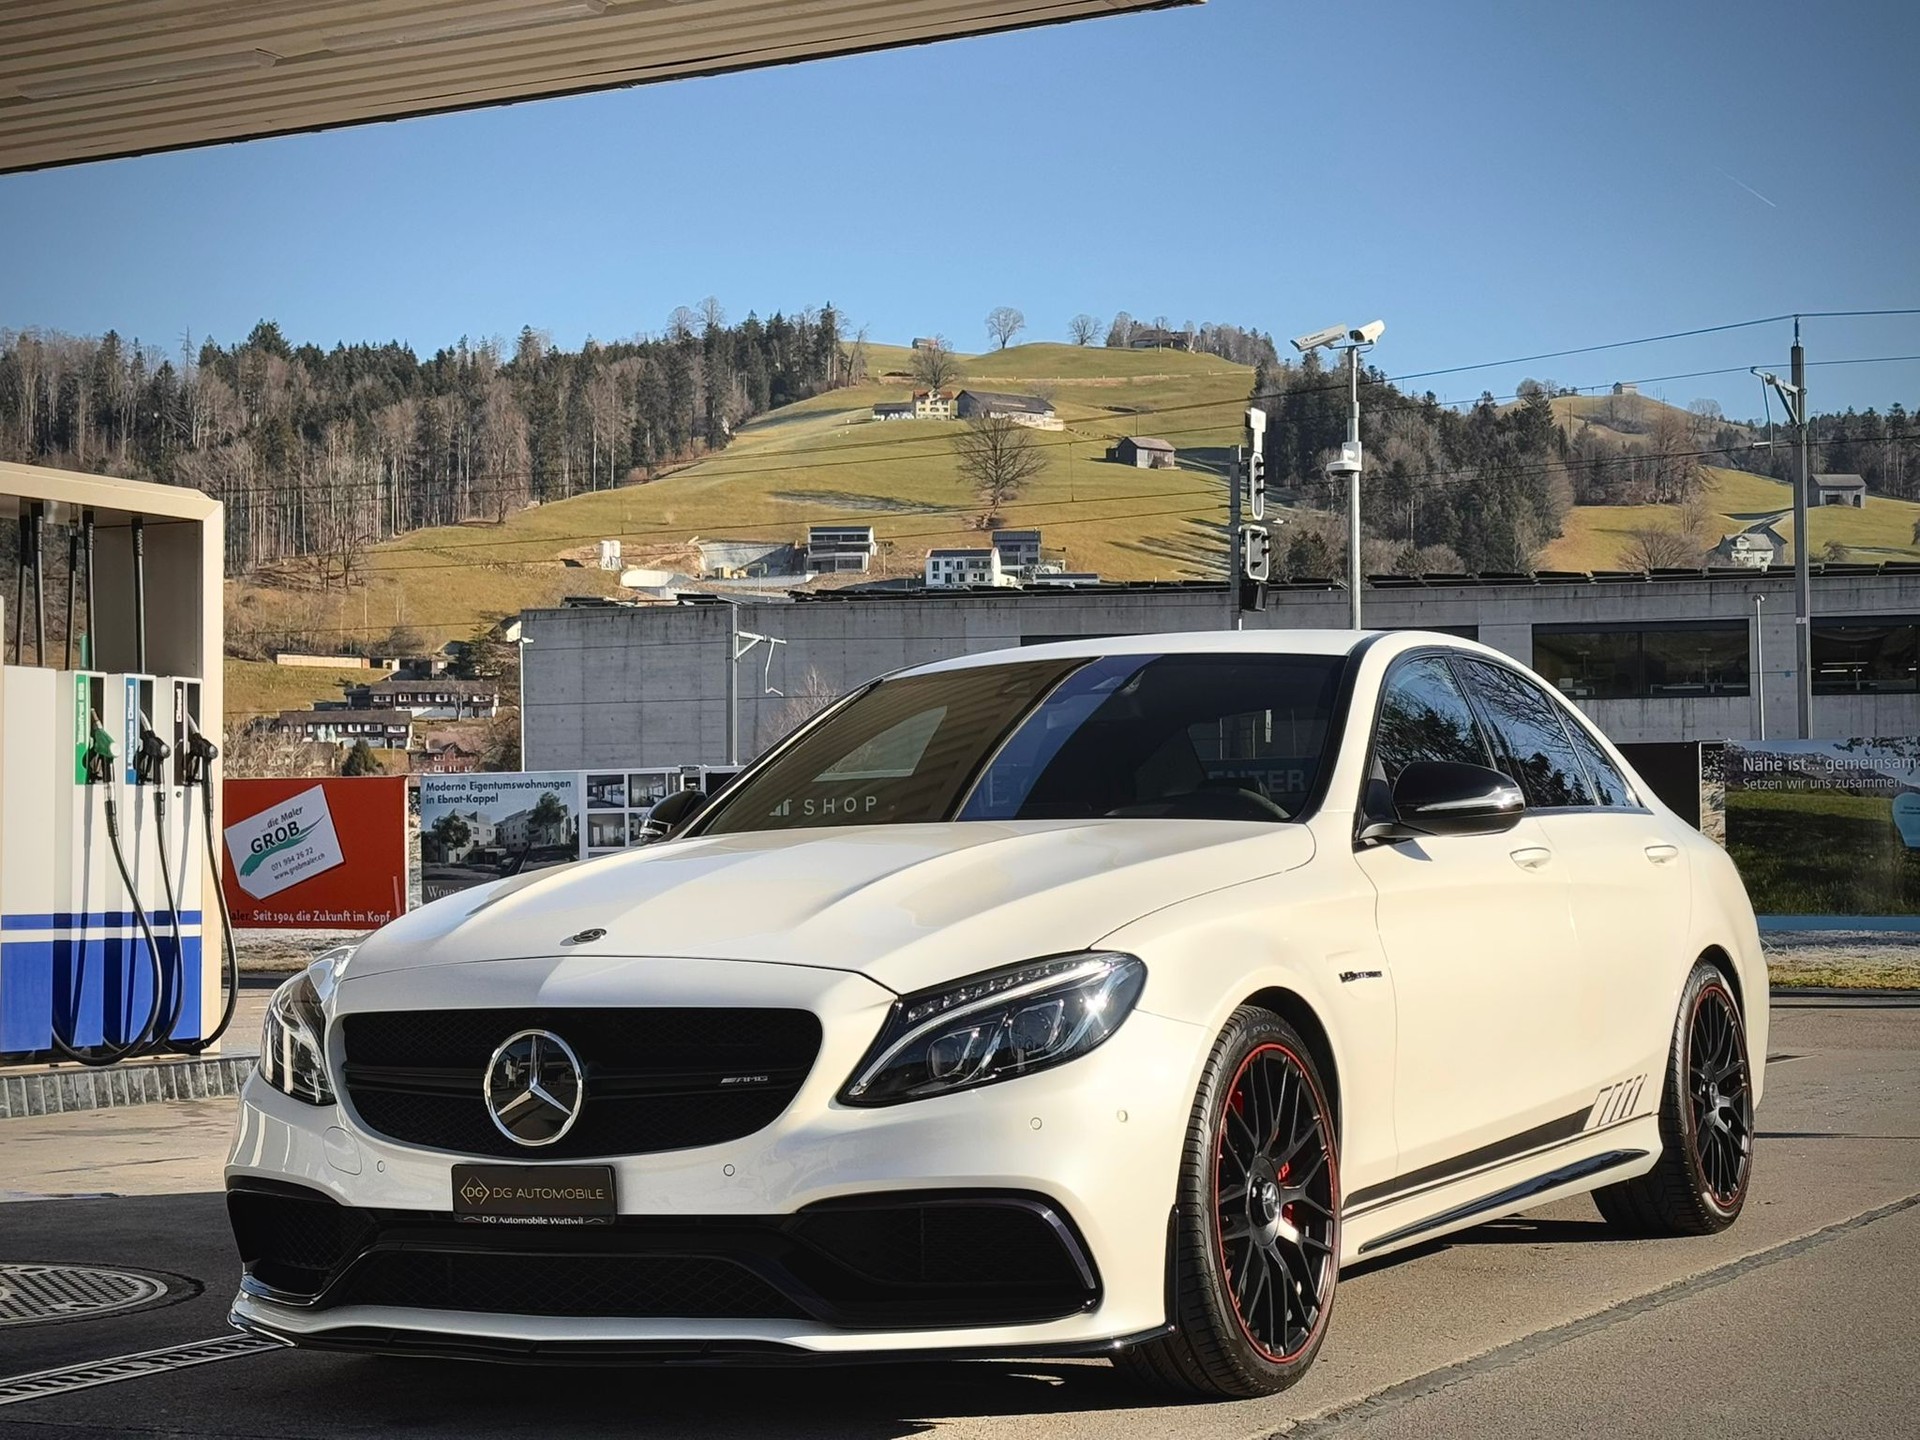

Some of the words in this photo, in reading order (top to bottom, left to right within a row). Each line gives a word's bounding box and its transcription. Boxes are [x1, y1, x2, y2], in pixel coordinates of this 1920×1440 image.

[175, 688, 183, 723] Diesel
[1743, 756, 1783, 772] Nähe
[1788, 756, 1820, 772] ist...
[1825, 756, 1917, 774] gemeinsam
[426, 782, 467, 792] Moderne
[469, 779, 572, 793] Eigentumswohnungen
[1743, 779, 1783, 790] Setzen
[1786, 778, 1806, 790] wir
[1810, 779, 1832, 790] uns
[426, 795, 435, 804] in
[437, 793, 499, 805] Ebnat-Kappel
[803, 796, 878, 816] SHOP
[281, 806, 303, 822] Maler
[250, 820, 301, 854] GROB
[252, 909, 272, 921] Seit
[273, 910, 295, 924] 1904
[295, 909, 311, 921] die
[312, 909, 351, 922] Zukunft
[353, 912, 365, 922] im
[466, 1187, 483, 1197] DG
[493, 1187, 512, 1198] DG
[516, 1188, 604, 1199] AUTOMOBILE
[499, 1215, 548, 1225] Automobile
